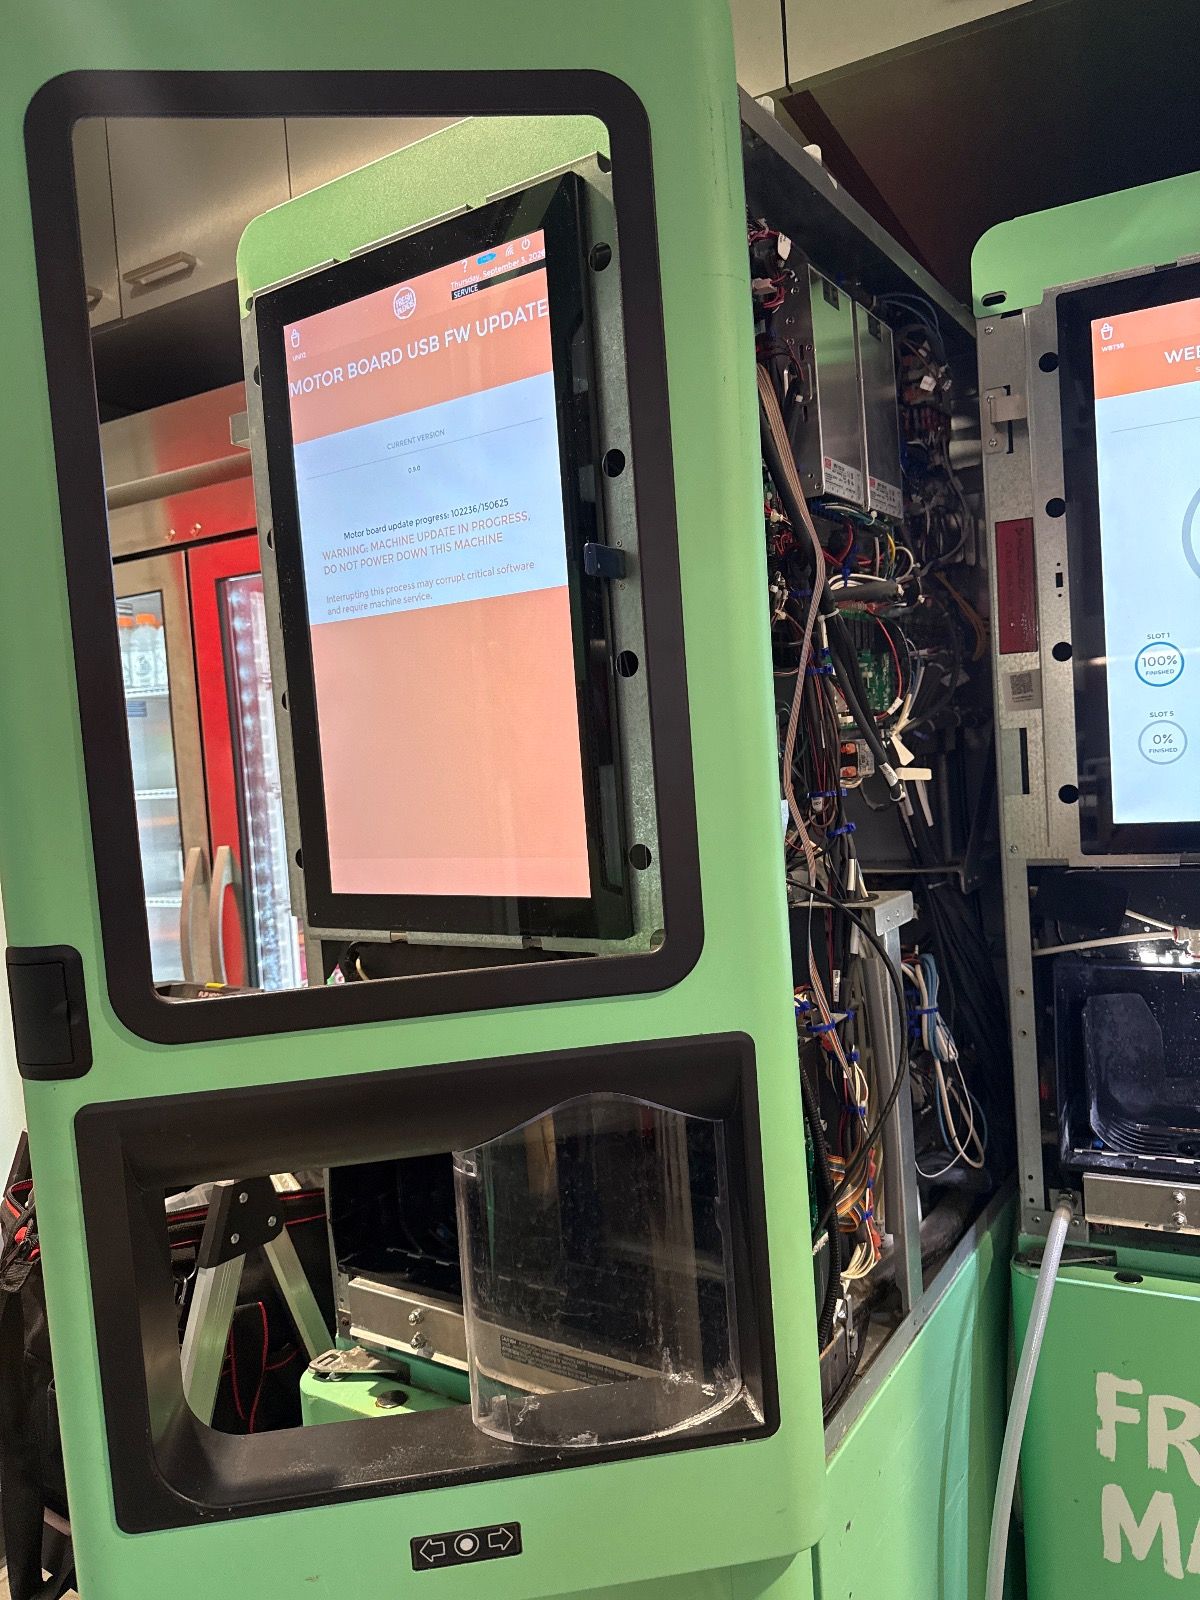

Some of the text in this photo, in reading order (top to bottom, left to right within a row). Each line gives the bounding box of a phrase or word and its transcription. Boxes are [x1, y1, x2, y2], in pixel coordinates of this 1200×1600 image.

[451, 273, 480, 289] Thursday,
[482, 259, 520, 278] September
[453, 284, 479, 299] SERVICE
[288, 298, 549, 398] MOTOR BOARD USB FW UPDATE
[386, 428, 445, 450] CURRENT VERSION
[343, 498, 509, 540] Motor board update progress: 102236/150625
[322, 511, 530, 560] WARNING: MACHINE UPDATE IN PROGRESS,
[324, 532, 504, 575] DO NOT POWER DOWN THIS MACHINE
[327, 561, 535, 604] Interrupting this process may corrupt critical software
[328, 594, 432, 615] and require machine service.
[1142, 655, 1177, 667] 100%
[1145, 668, 1175, 676] FINISHED
[1152, 733, 1174, 744] 0%
[1101, 1483, 1200, 1579] M
